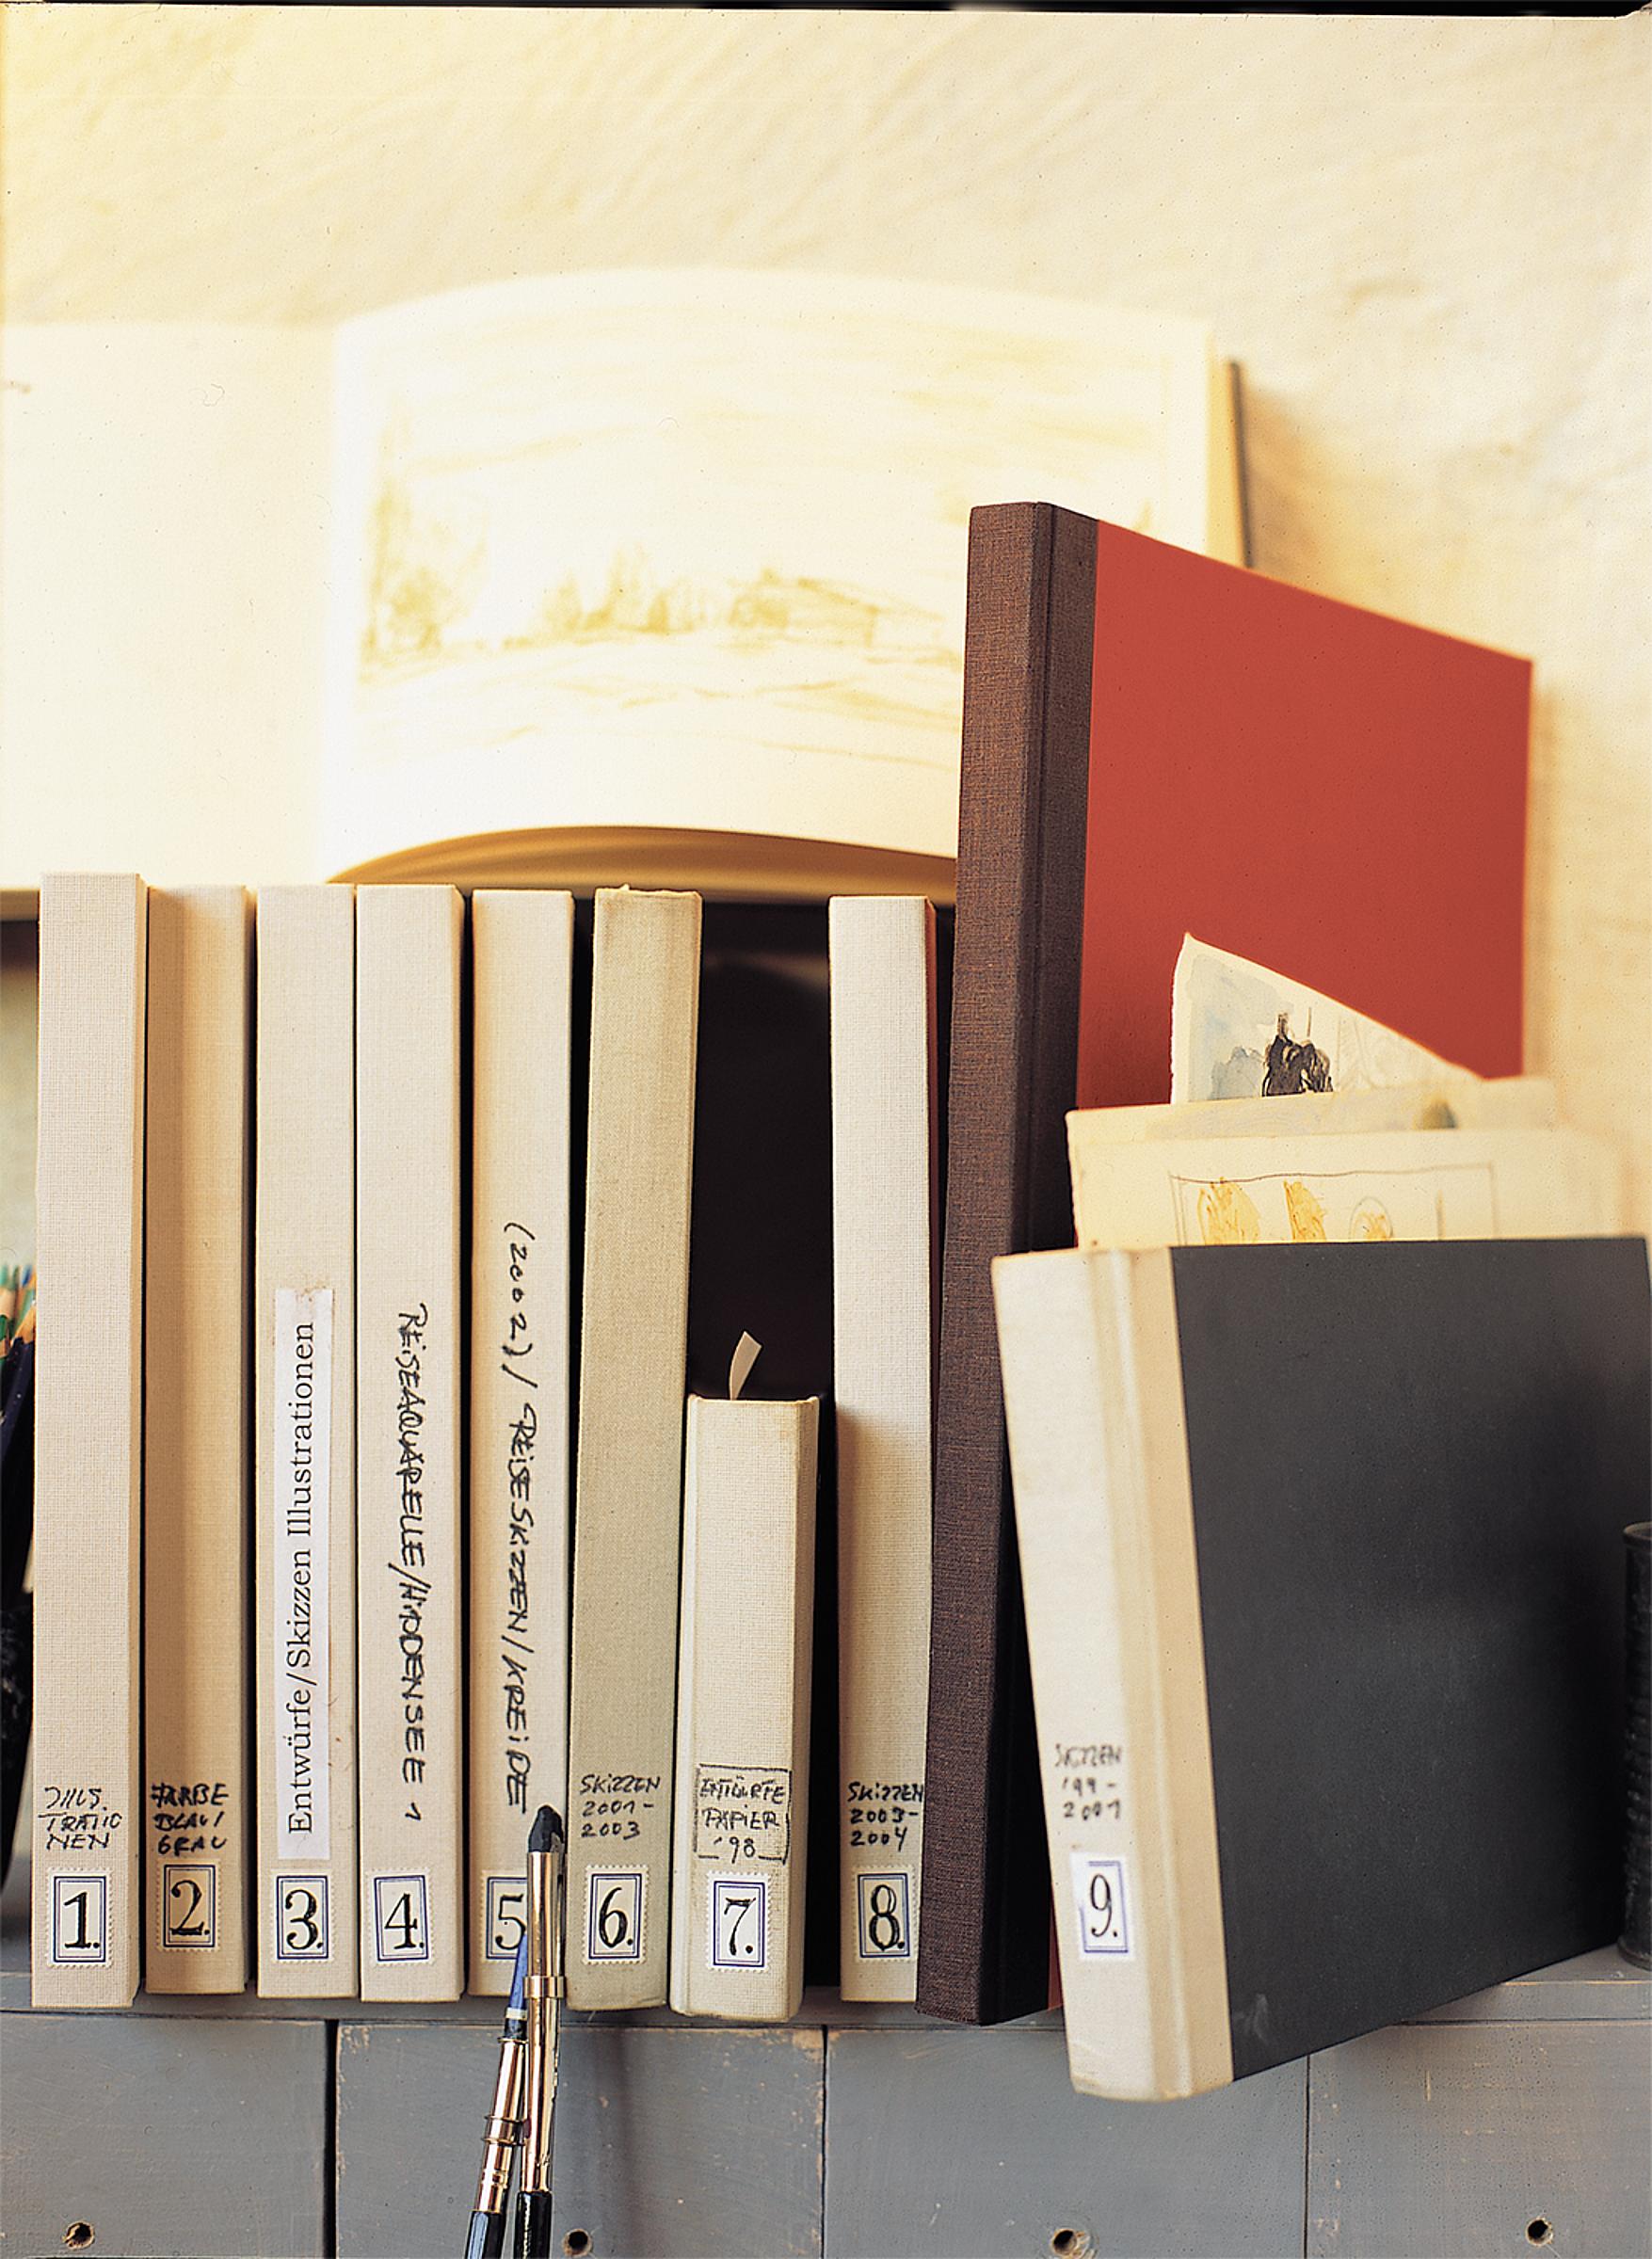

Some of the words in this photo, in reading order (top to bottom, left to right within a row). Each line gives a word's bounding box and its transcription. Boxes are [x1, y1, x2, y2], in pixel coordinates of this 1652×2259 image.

[284, 1322, 315, 1538] Illustrationen
[284, 1548, 318, 1834] Entwürfe/Skizzen
[45, 1832, 110, 1850] NEN
[158, 1834, 227, 1856] GRAU
[581, 1820, 641, 1840] 2003
[850, 1826, 907, 1852] 2004
[62, 1892, 101, 1949] 1.
[168, 1880, 211, 1936] 2.
[284, 1889, 324, 1951] 3.
[384, 1893, 425, 1949] 4.
[598, 1886, 634, 1948] 6.
[723, 1897, 757, 1956] 7.
[869, 1883, 906, 1952] 8.
[1089, 1874, 1118, 1937] 9.
